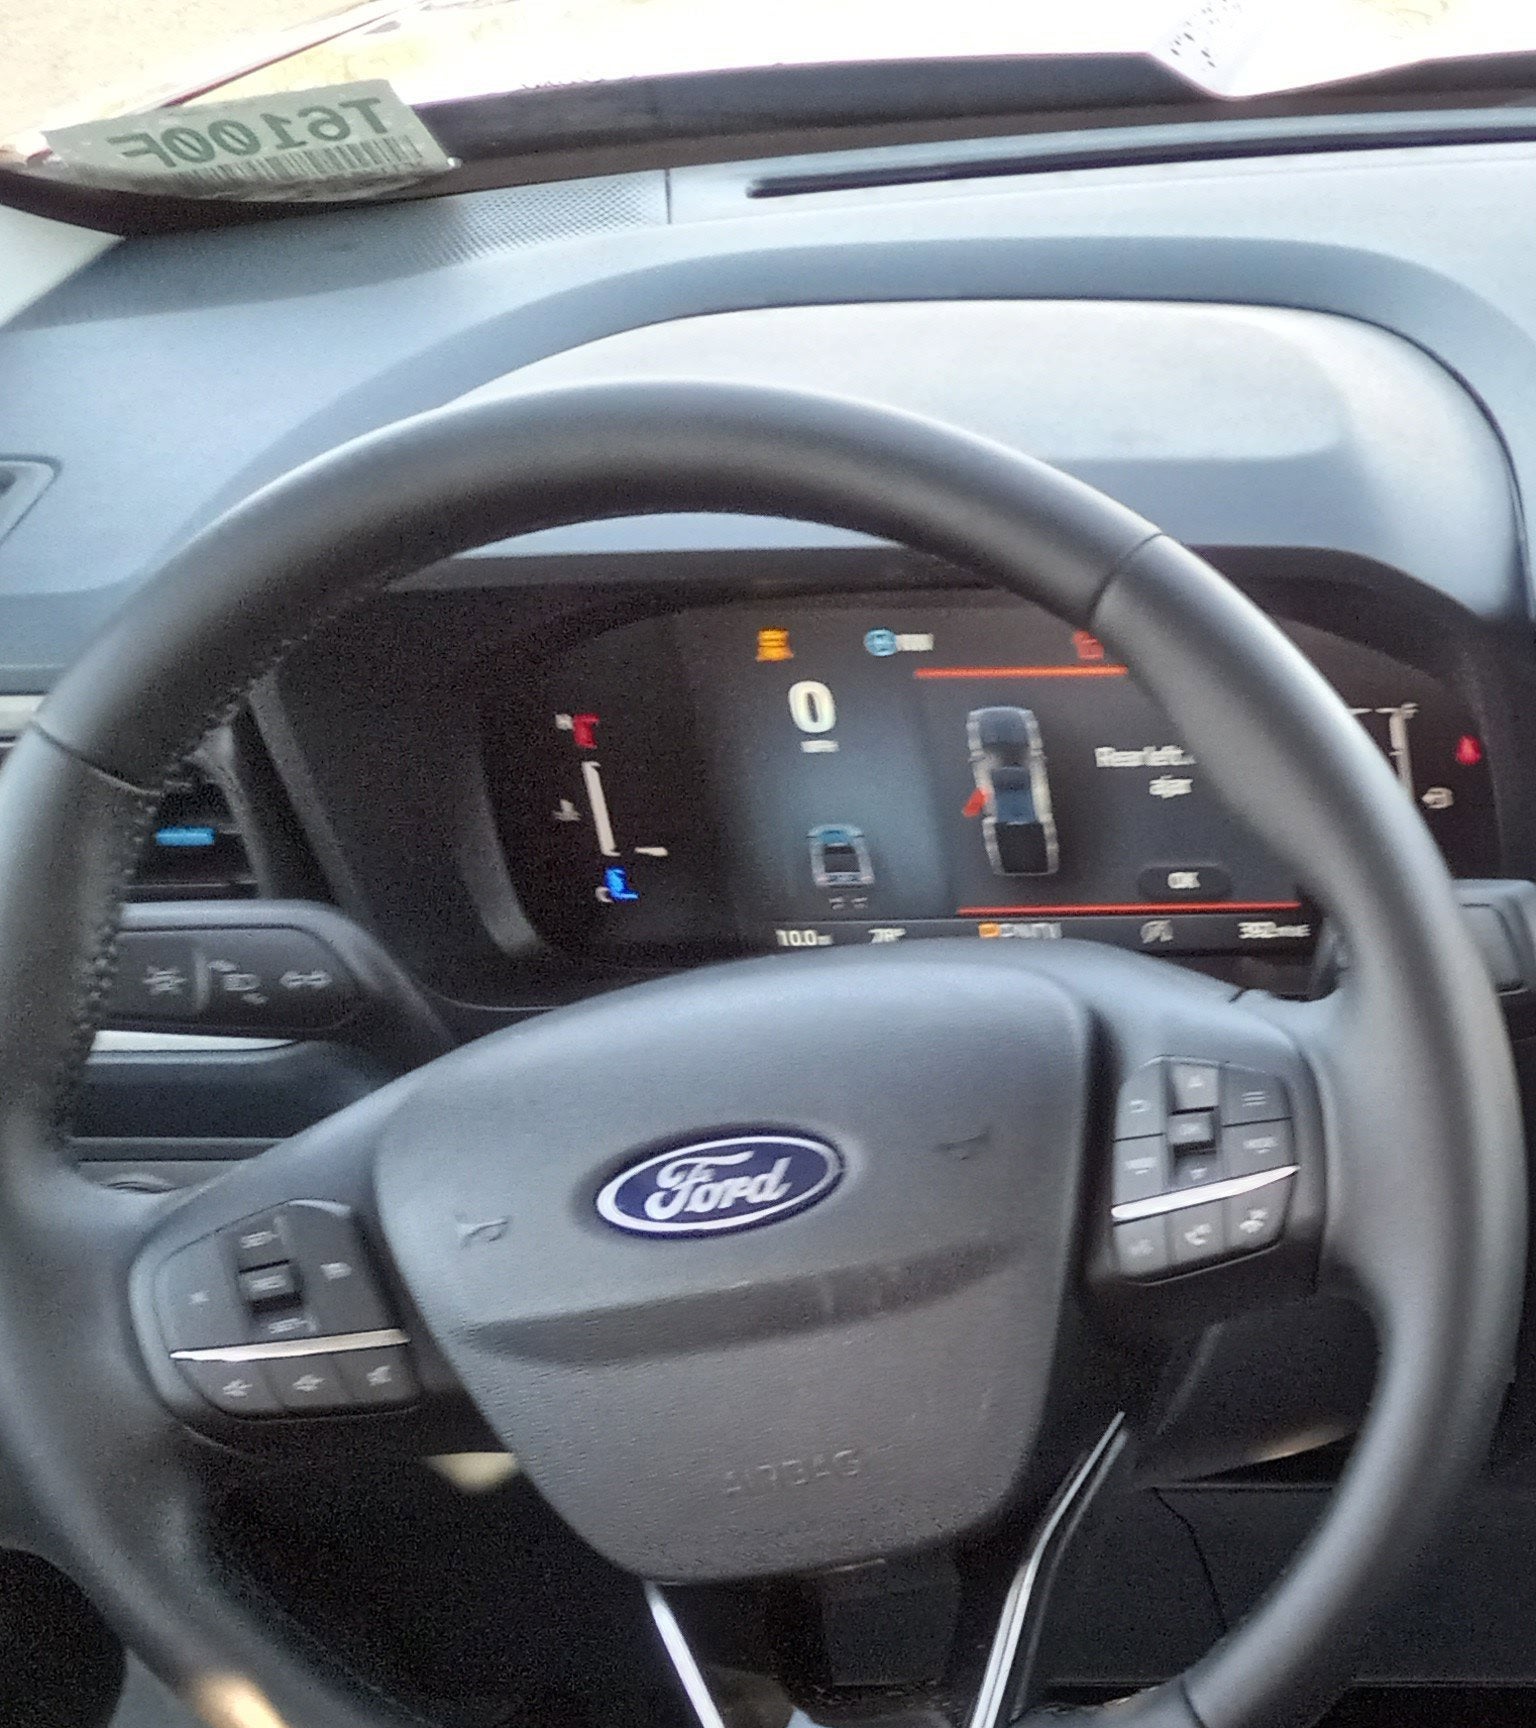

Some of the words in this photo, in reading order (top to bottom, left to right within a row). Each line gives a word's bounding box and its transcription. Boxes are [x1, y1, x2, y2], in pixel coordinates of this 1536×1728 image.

[788, 681, 836, 734] 0
[1167, 872, 1201, 889] OK
[645, 1151, 792, 1220] Ford
